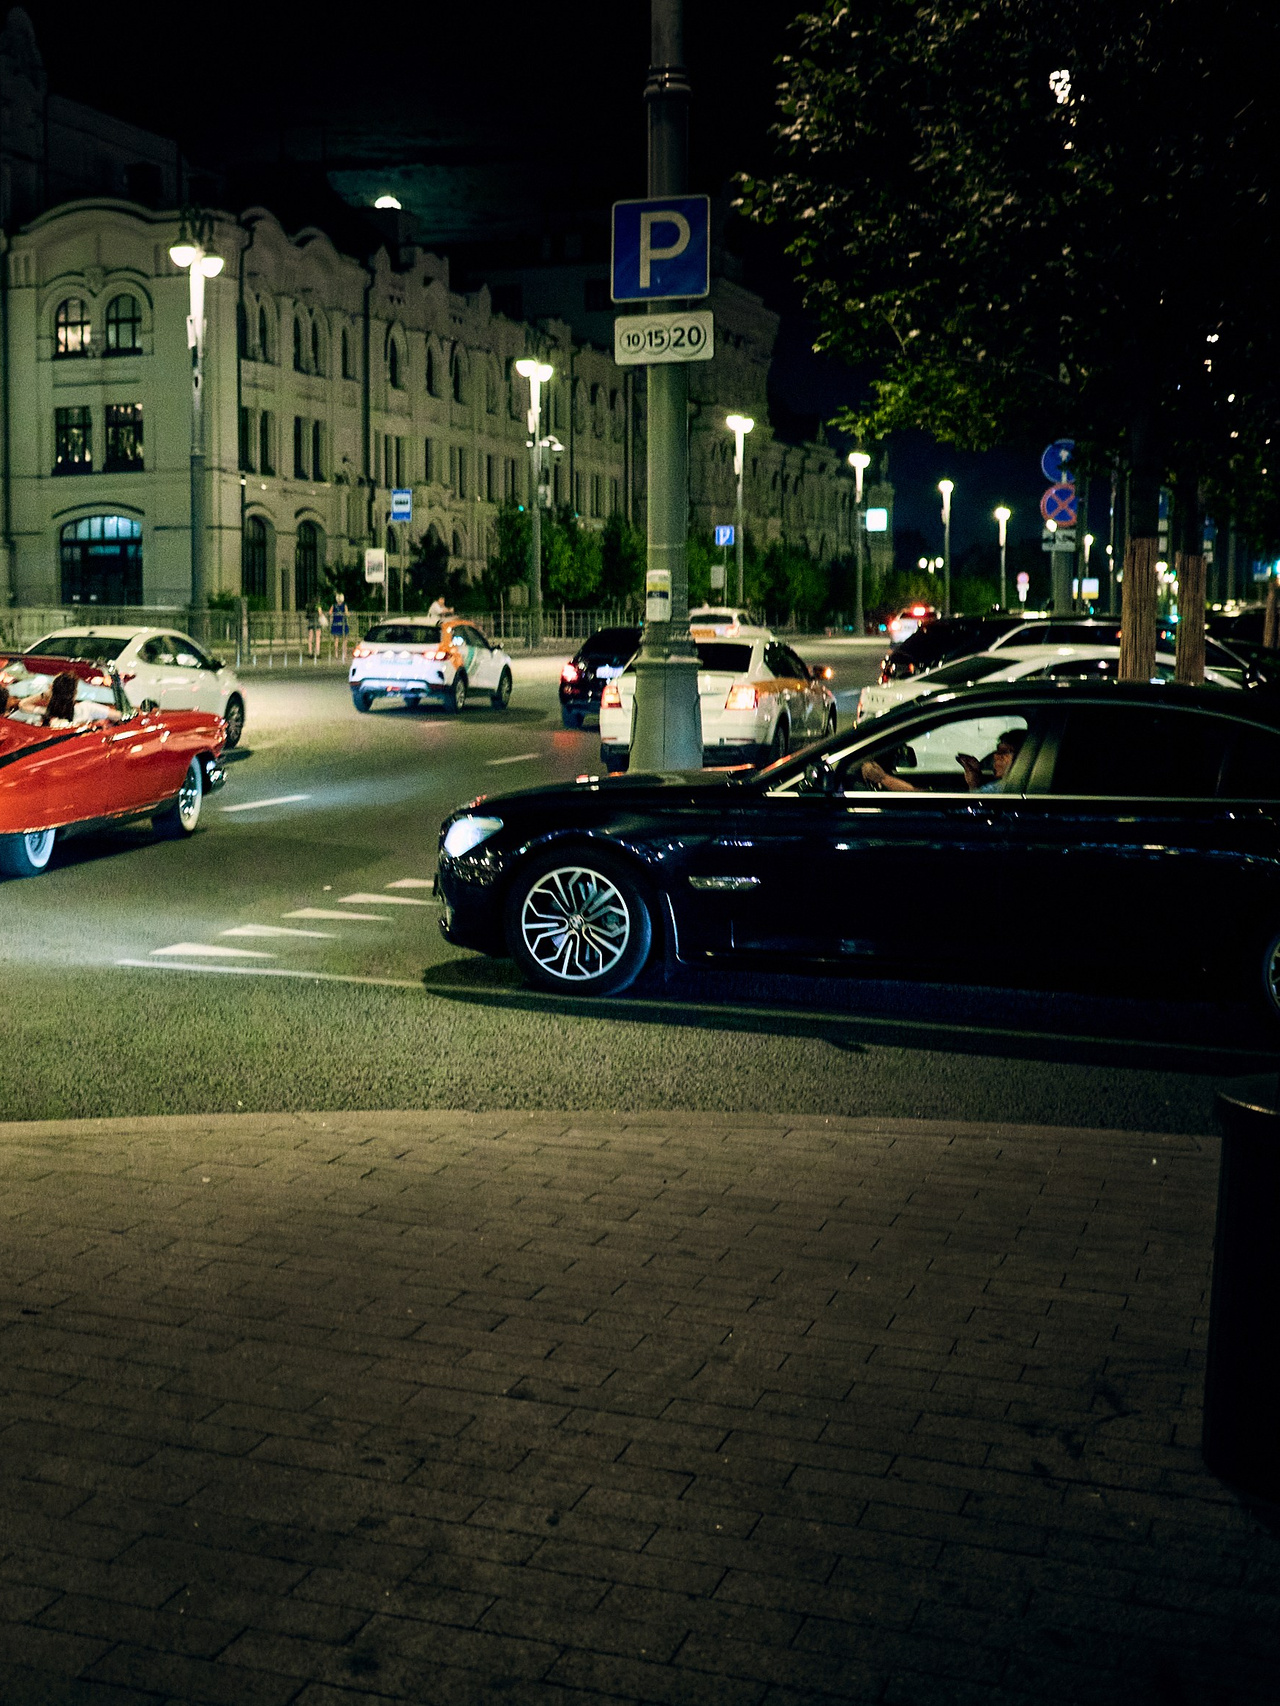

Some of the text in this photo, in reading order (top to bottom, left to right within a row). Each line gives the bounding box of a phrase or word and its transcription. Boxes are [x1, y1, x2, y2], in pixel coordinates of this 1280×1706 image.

[639, 210, 691, 289] P
[626, 325, 702, 347] 10 15 20
